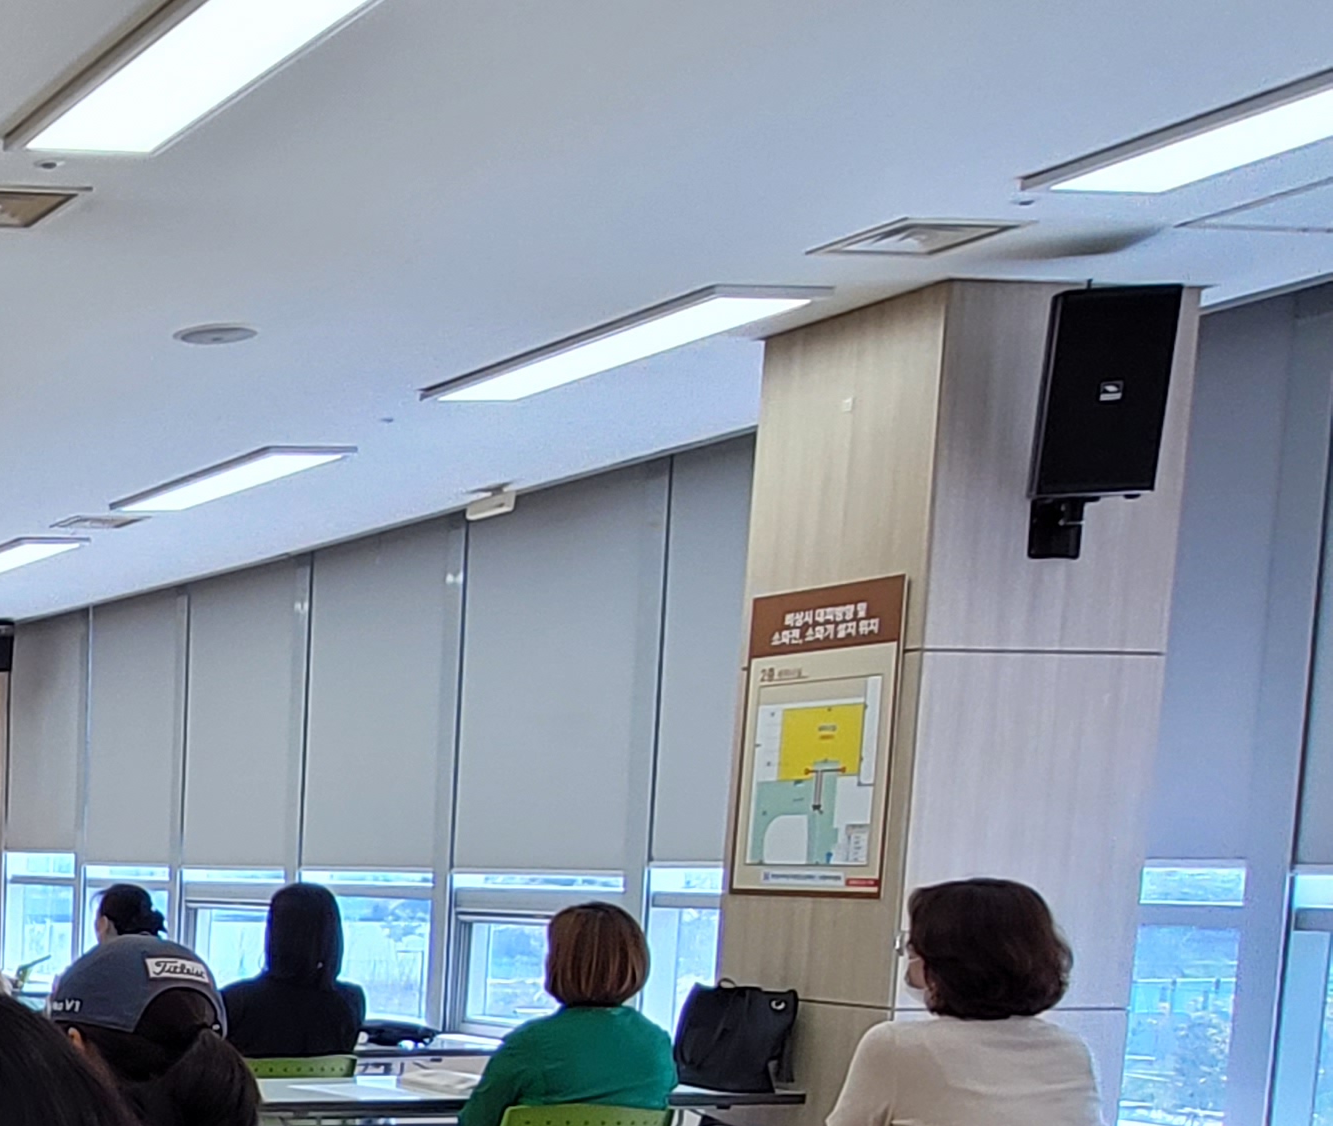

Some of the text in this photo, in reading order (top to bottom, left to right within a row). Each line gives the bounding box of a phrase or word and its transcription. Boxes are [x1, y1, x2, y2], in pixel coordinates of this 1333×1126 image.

[805, 624, 835, 641] 소화기
[836, 621, 857, 639] 설치
[859, 617, 880, 636] 위치
